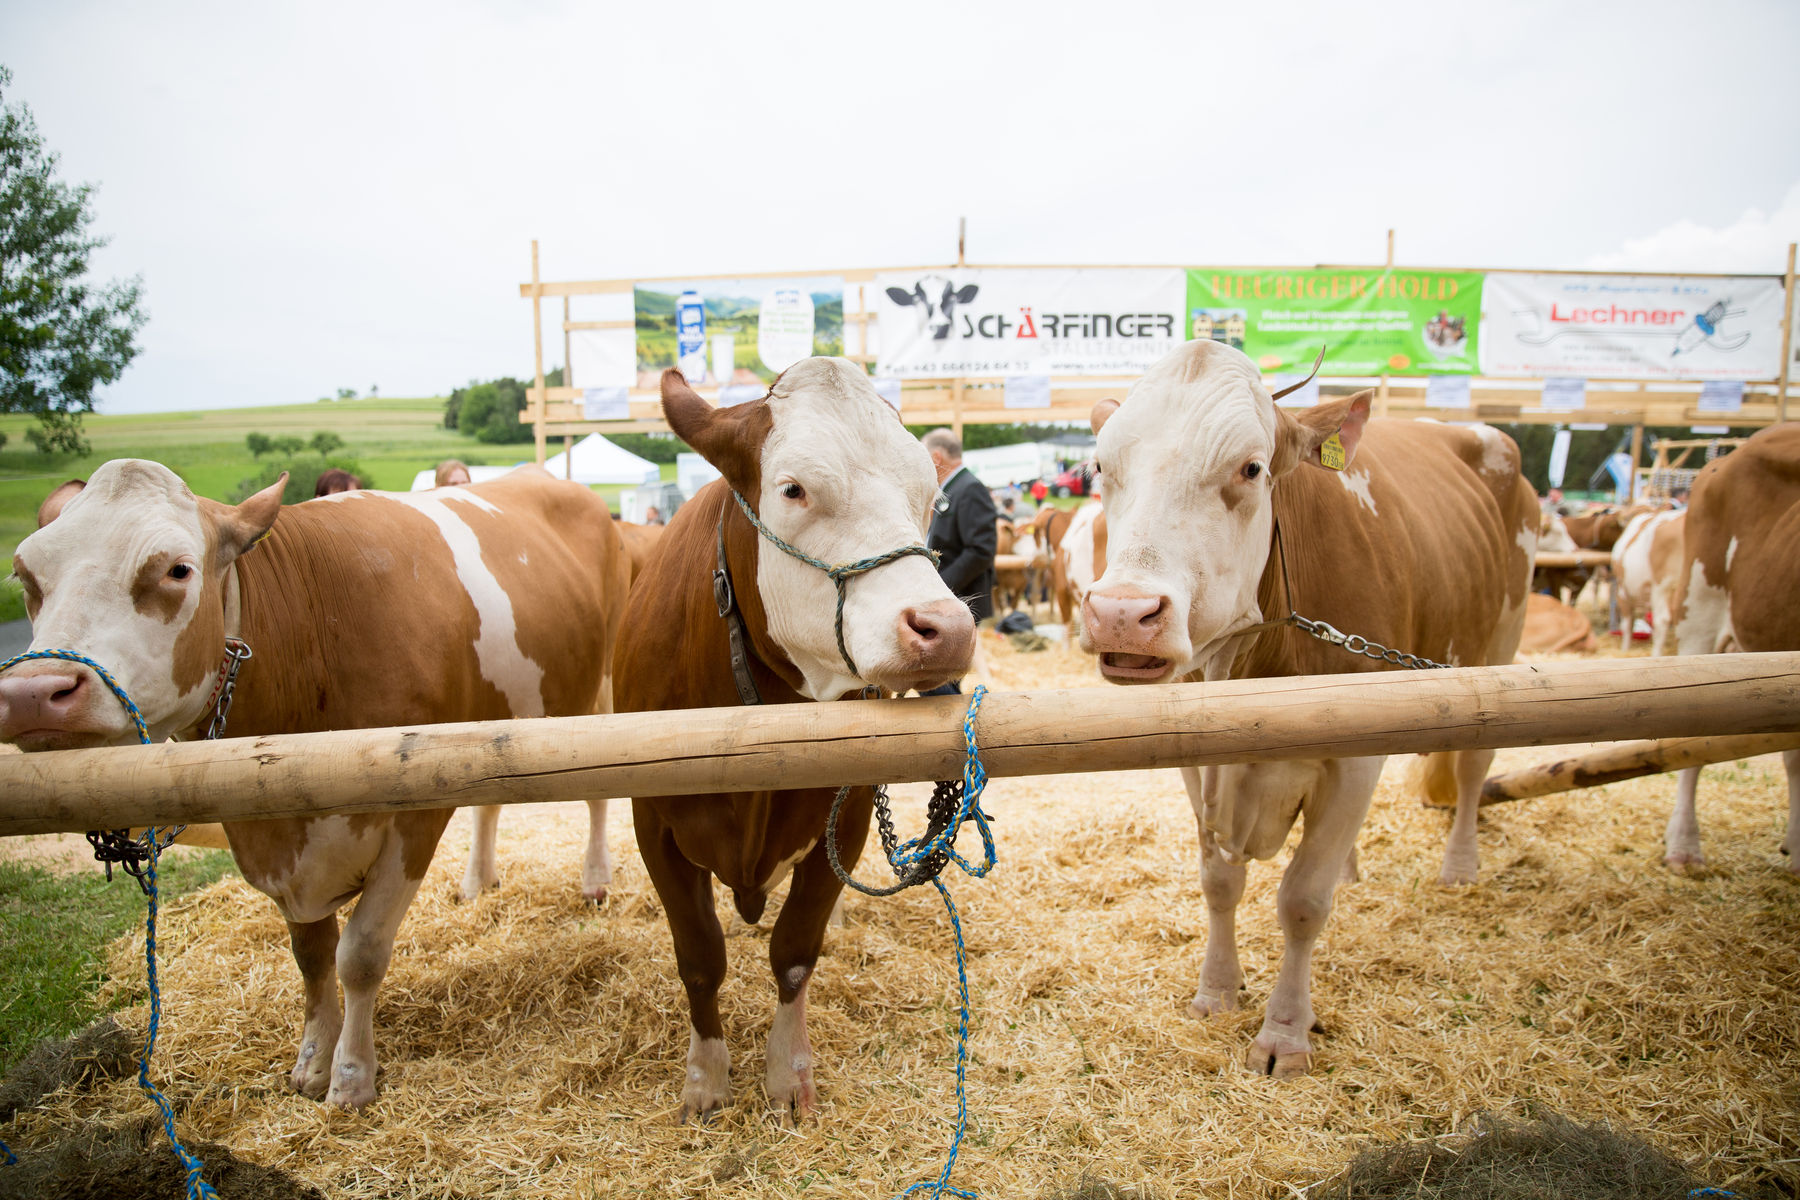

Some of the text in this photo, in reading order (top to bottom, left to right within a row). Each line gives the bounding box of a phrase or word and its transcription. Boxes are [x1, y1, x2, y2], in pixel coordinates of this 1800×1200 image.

[1211, 275, 1458, 300] HEURIGER HOLD
[1550, 303, 1685, 325] Lechner
